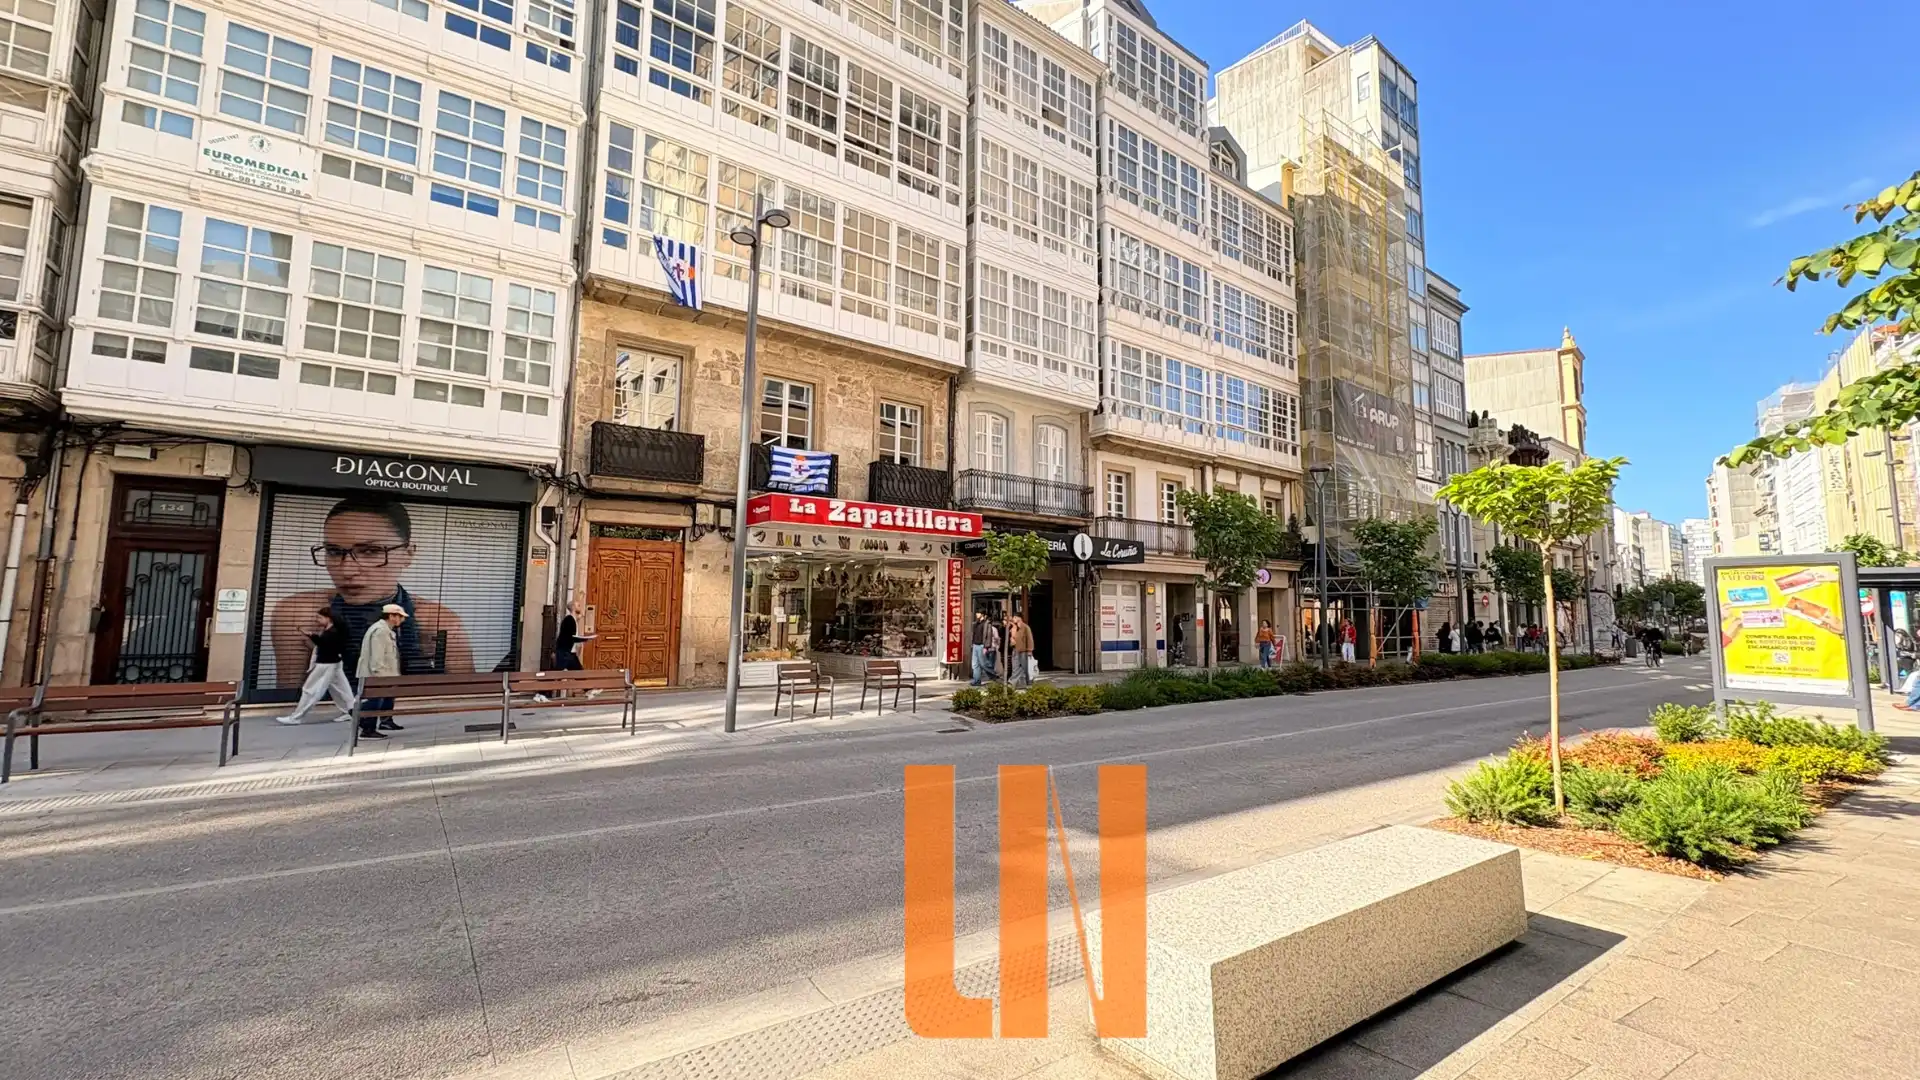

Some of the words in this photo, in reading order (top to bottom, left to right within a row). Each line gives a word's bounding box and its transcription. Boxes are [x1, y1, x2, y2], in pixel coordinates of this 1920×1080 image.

[203, 148, 309, 181] EUROMEDICAL
[1369, 407, 1399, 430] ARUP
[331, 456, 478, 486] DIAGONAL
[365, 477, 400, 489] ÓPTICA
[402, 481, 449, 493] BOUTIQUE
[160, 503, 185, 512] 134
[789, 498, 817, 514] La
[828, 500, 973, 533] Zapatillera
[1100, 541, 1112, 558] La
[1111, 543, 1138, 559] Coruña
[949, 561, 961, 643] Zapatillera
[949, 647, 959, 662] La
